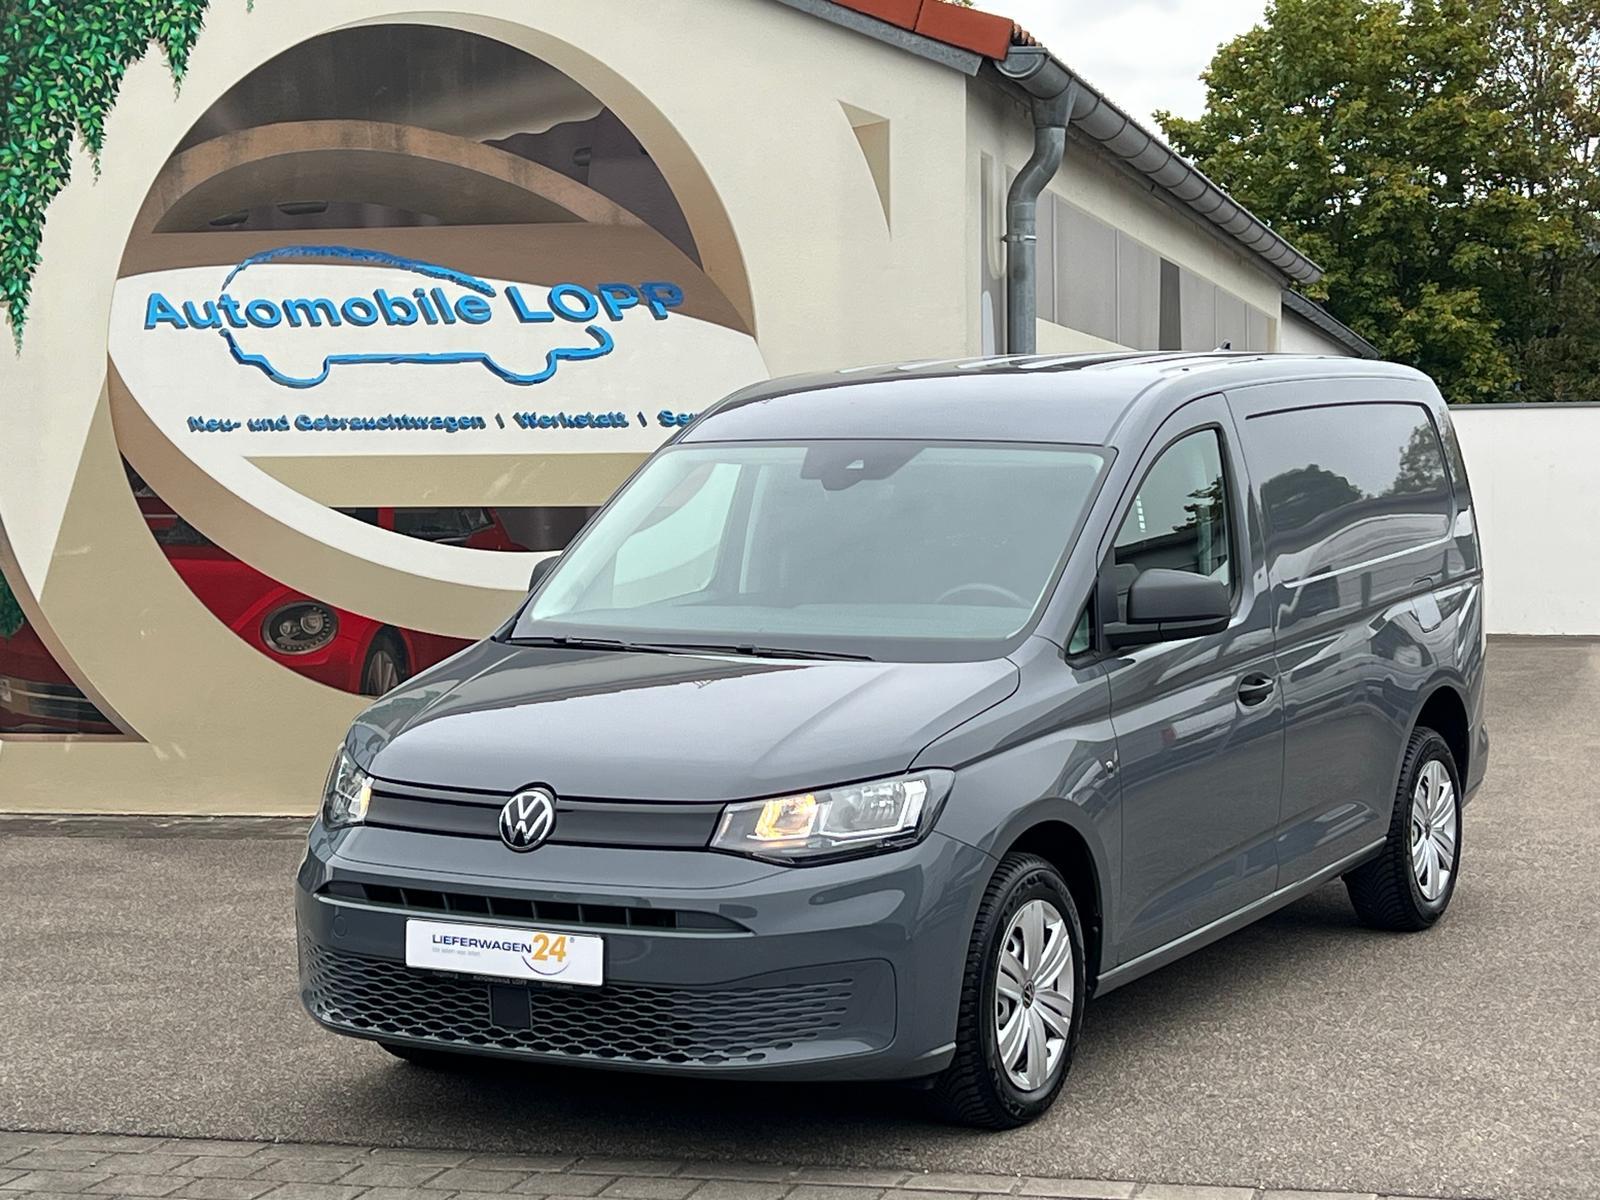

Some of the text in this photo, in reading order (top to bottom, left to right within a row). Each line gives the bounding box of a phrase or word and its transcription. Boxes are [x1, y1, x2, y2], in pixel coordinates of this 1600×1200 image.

[144, 282, 684, 329] Automobile LOPP
[187, 416, 241, 432] Neu-
[247, 415, 290, 431] und
[294, 413, 486, 432] Gebrauchtwagen
[513, 411, 629, 429] Werkstatt
